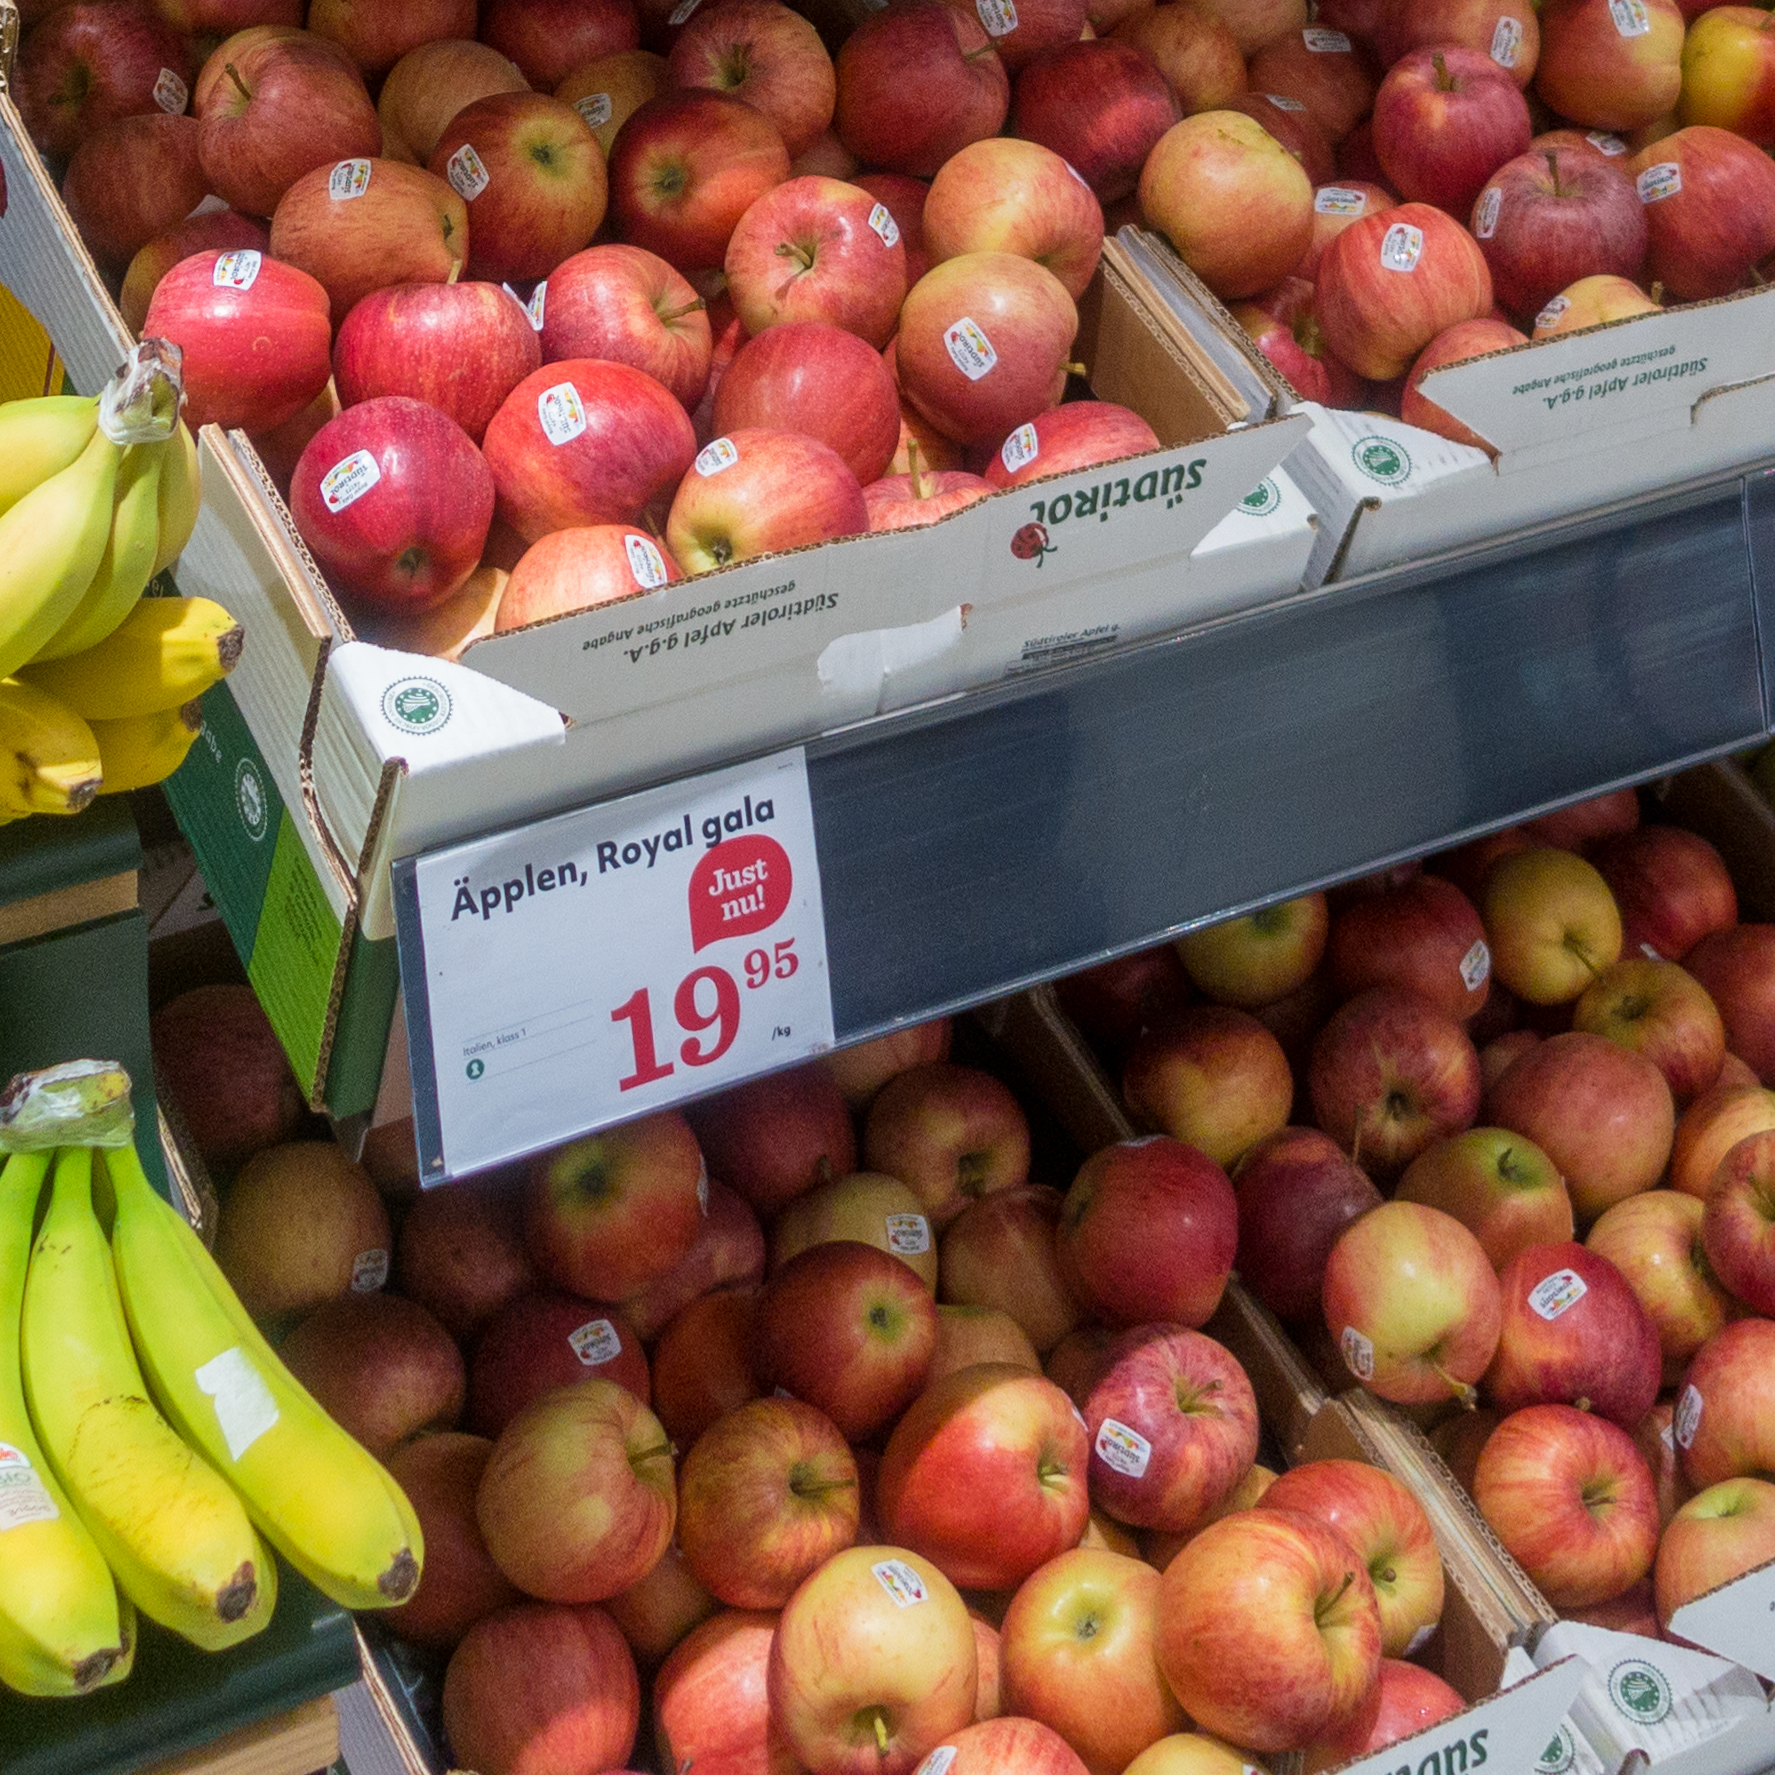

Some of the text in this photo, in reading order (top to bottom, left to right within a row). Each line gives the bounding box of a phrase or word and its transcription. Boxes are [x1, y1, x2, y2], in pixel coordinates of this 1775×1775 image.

[1512, 346, 1676, 397] geschützte geografische Angabe
[1594, 376, 1630, 400] Apfel
[1634, 357, 1709, 386] Südtiroler
[582, 580, 796, 652] geschützte geografische Angabe
[742, 592, 840, 632] Südtiroler
[683, 617, 739, 650] Apfel
[450, 794, 775, 922] Äpplen, Royal gala
[708, 857, 768, 897] Just
[721, 884, 766, 922] nu!
[610, 937, 800, 1094] 19 95
[771, 1025, 792, 1041] /kg
[496, 1033, 520, 1045] klass
